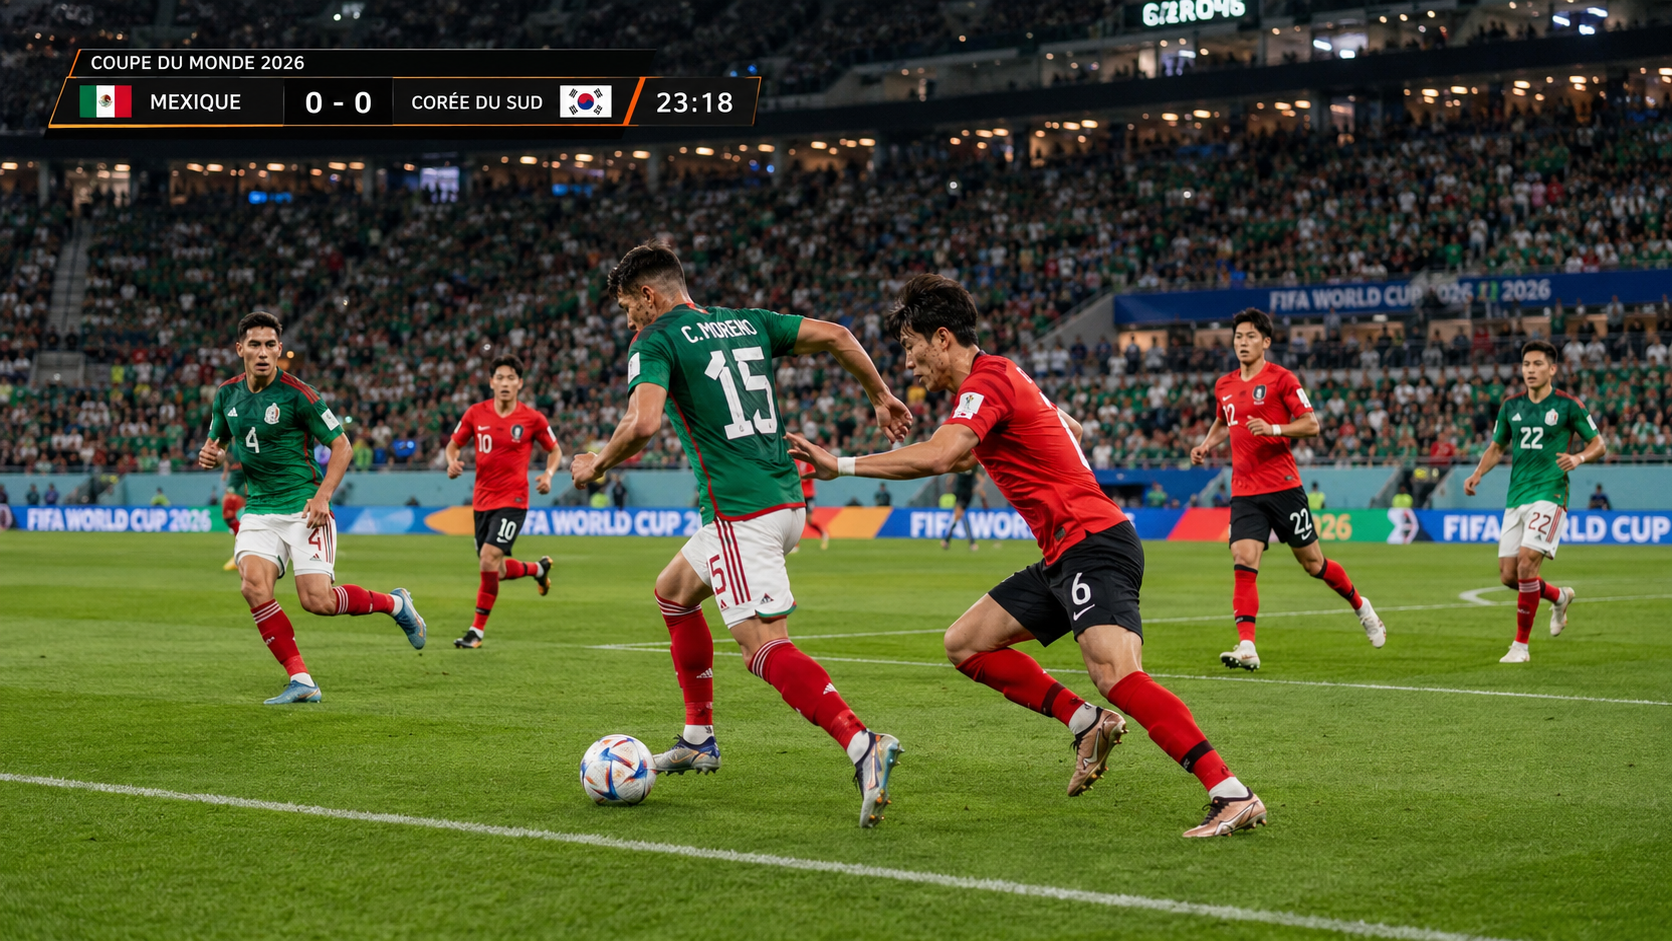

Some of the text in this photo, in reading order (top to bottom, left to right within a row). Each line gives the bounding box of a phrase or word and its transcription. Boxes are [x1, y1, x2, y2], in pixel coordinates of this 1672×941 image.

[1269, 289, 1310, 311] FIFA
[1312, 286, 1381, 310] WORLD
[1384, 284, 1422, 307] CUP
[1501, 279, 1551, 301] 2026
[704, 346, 778, 440] 15
[245, 427, 260, 453] 4
[477, 433, 492, 454] 10
[1520, 427, 1544, 449] 22
[26, 508, 212, 532] FIFA WORLD CUP 2026
[497, 518, 517, 541] 10
[550, 509, 633, 536] WORLD
[634, 509, 682, 537] CUP
[967, 511, 1036, 539] WOR
[1290, 508, 1312, 535] 22
[1443, 515, 1501, 542] FIFA
[1611, 515, 1672, 544] CUP
[1528, 512, 1552, 535] 22
[308, 527, 322, 551] 4
[1071, 572, 1092, 606] 6
